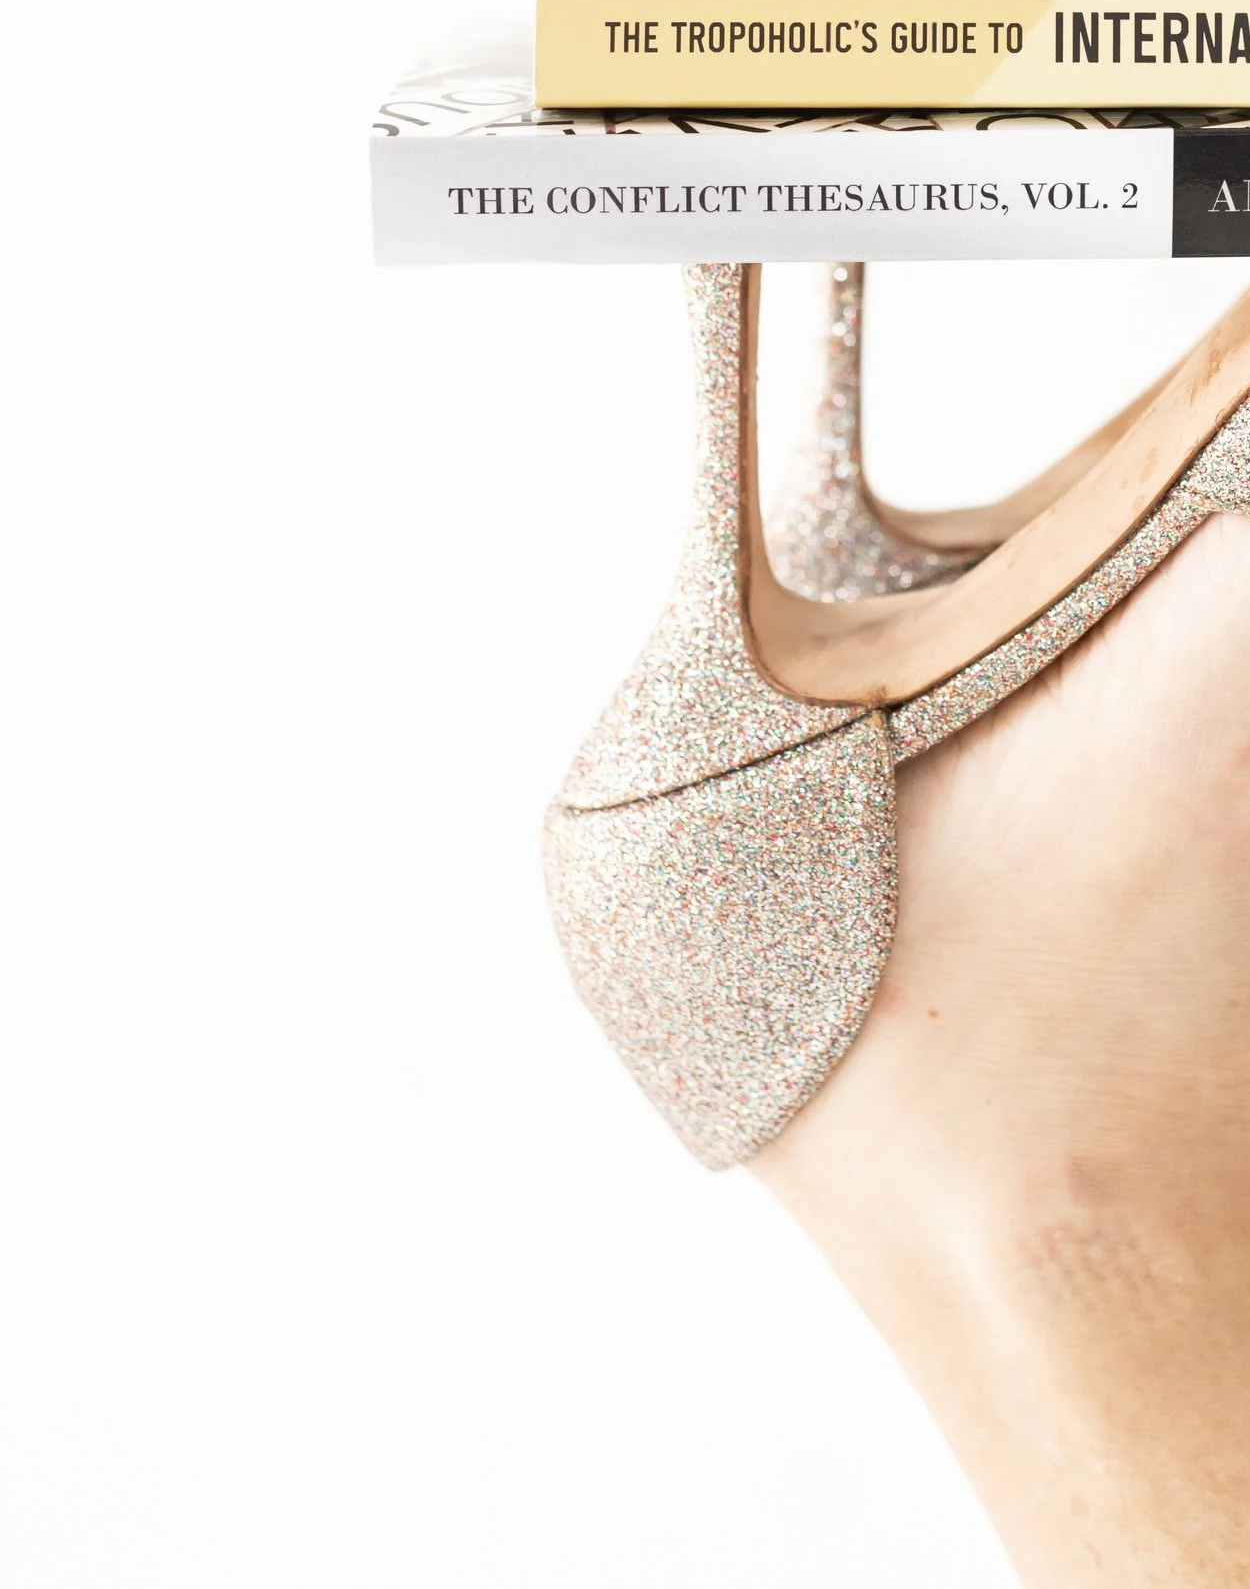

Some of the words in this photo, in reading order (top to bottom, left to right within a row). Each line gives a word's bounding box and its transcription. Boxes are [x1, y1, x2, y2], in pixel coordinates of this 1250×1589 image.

[604, 21, 659, 53] THE
[670, 19, 878, 54] TROPOHOLIC'S
[891, 21, 977, 54] GUIDE
[987, 22, 1023, 54] TO
[448, 187, 534, 215] THE
[546, 185, 747, 215] CONFLICT
[757, 183, 1009, 216] THESAURUS,
[1021, 182, 1109, 210] VOL.
[1121, 182, 1138, 209] 2
